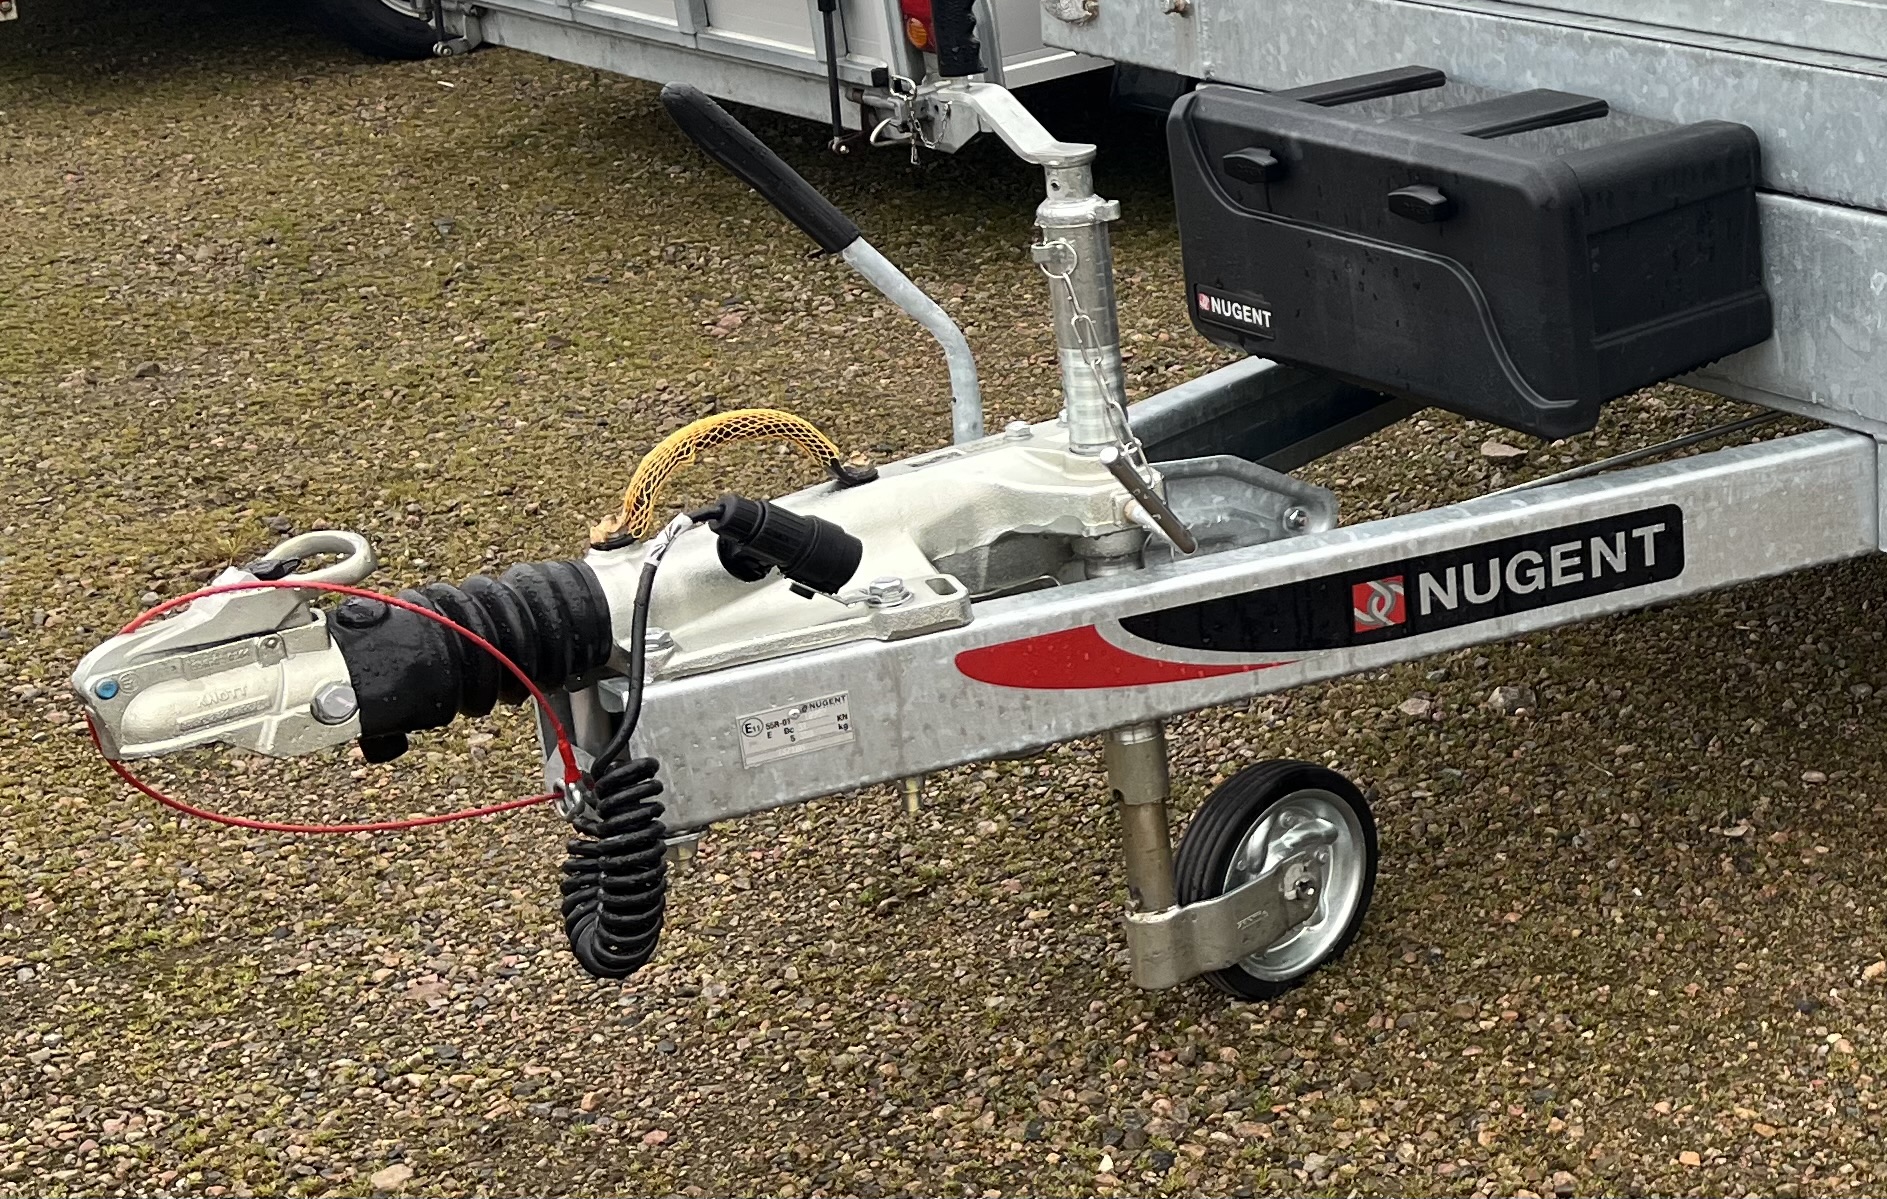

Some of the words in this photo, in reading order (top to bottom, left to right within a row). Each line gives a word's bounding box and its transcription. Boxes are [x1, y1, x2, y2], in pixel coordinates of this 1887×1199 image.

[1210, 296, 1272, 328] NUGENT
[1418, 523, 1666, 616] NUGENT
[809, 695, 847, 710] NUGENT
